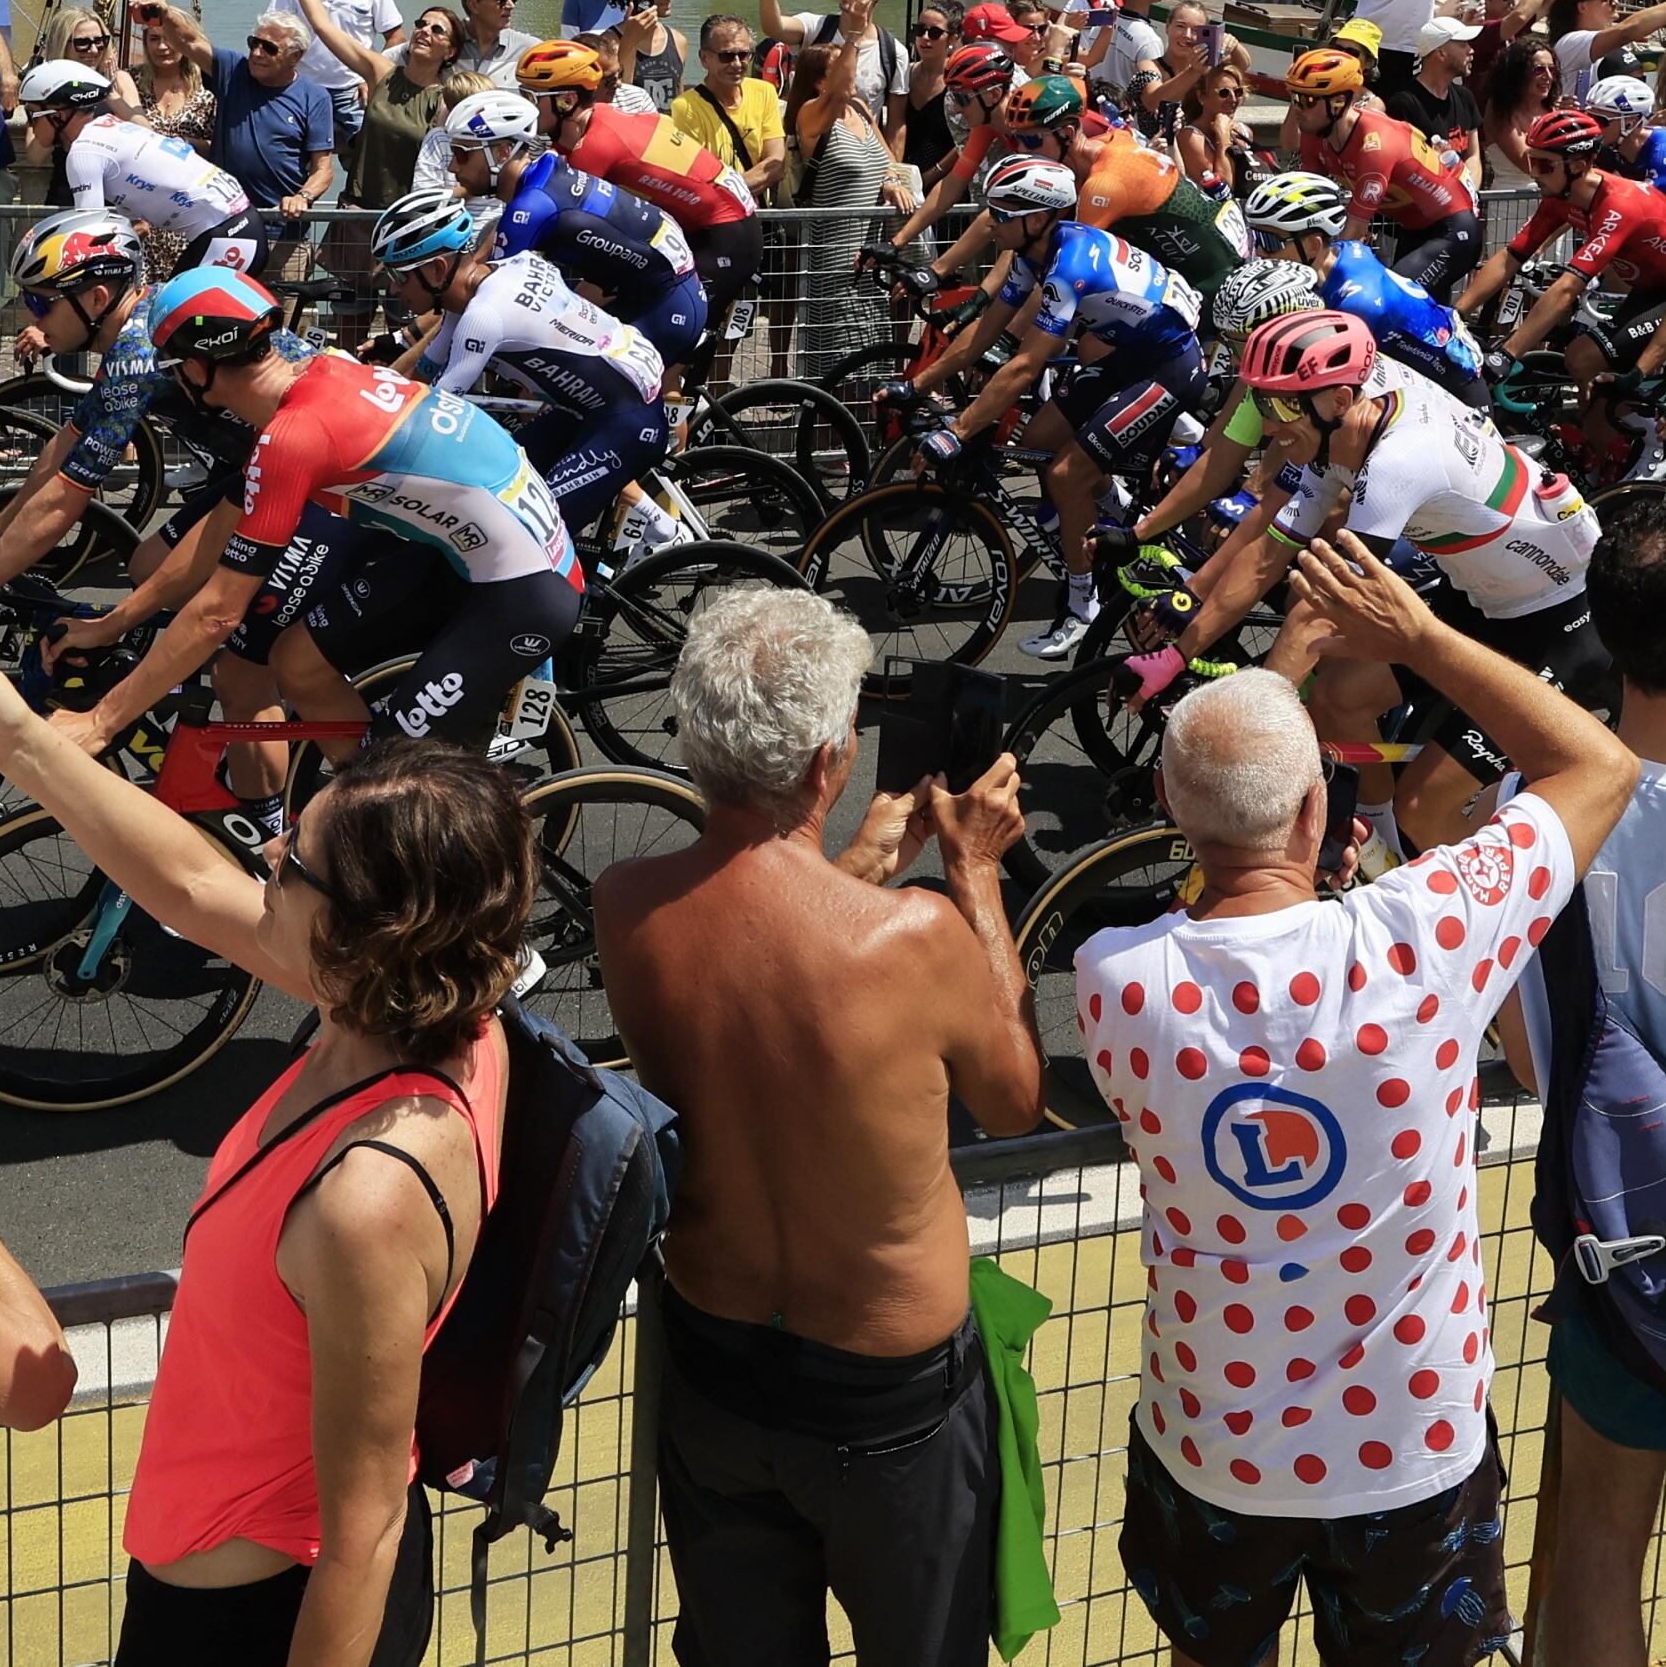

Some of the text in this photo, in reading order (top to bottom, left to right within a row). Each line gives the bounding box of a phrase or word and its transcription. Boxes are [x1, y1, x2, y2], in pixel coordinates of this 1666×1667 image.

[1043, 101, 1071, 124] GIANT
[125, 174, 156, 192] Krys
[638, 174, 671, 198] REMA
[1012, 184, 1068, 209] SPECIALIZED
[169, 191, 194, 209] Krys
[576, 229, 649, 270] Groupama
[1578, 210, 1623, 262] ARKEA
[1297, 298, 1320, 309] uvex
[1502, 296, 1520, 316] 207
[549, 317, 595, 347] MERIDA
[730, 307, 750, 333] 208
[1627, 323, 1654, 340] B&B
[106, 359, 155, 378] VISMA
[1296, 355, 1319, 382] EF
[1357, 341, 1373, 383] POC
[100, 383, 138, 399] lease
[523, 357, 606, 411] BAHRAIN
[1118, 394, 1178, 446] SOUDAL
[244, 434, 271, 516] lotto
[357, 484, 479, 546] MR SOLAR MR
[624, 517, 642, 539] 64
[989, 487, 1069, 582] S-WORKS
[268, 535, 312, 591] VISMA
[1505, 538, 1571, 587] cannondale
[519, 689, 552, 727] 128
[1462, 729, 1508, 773] Rapha
